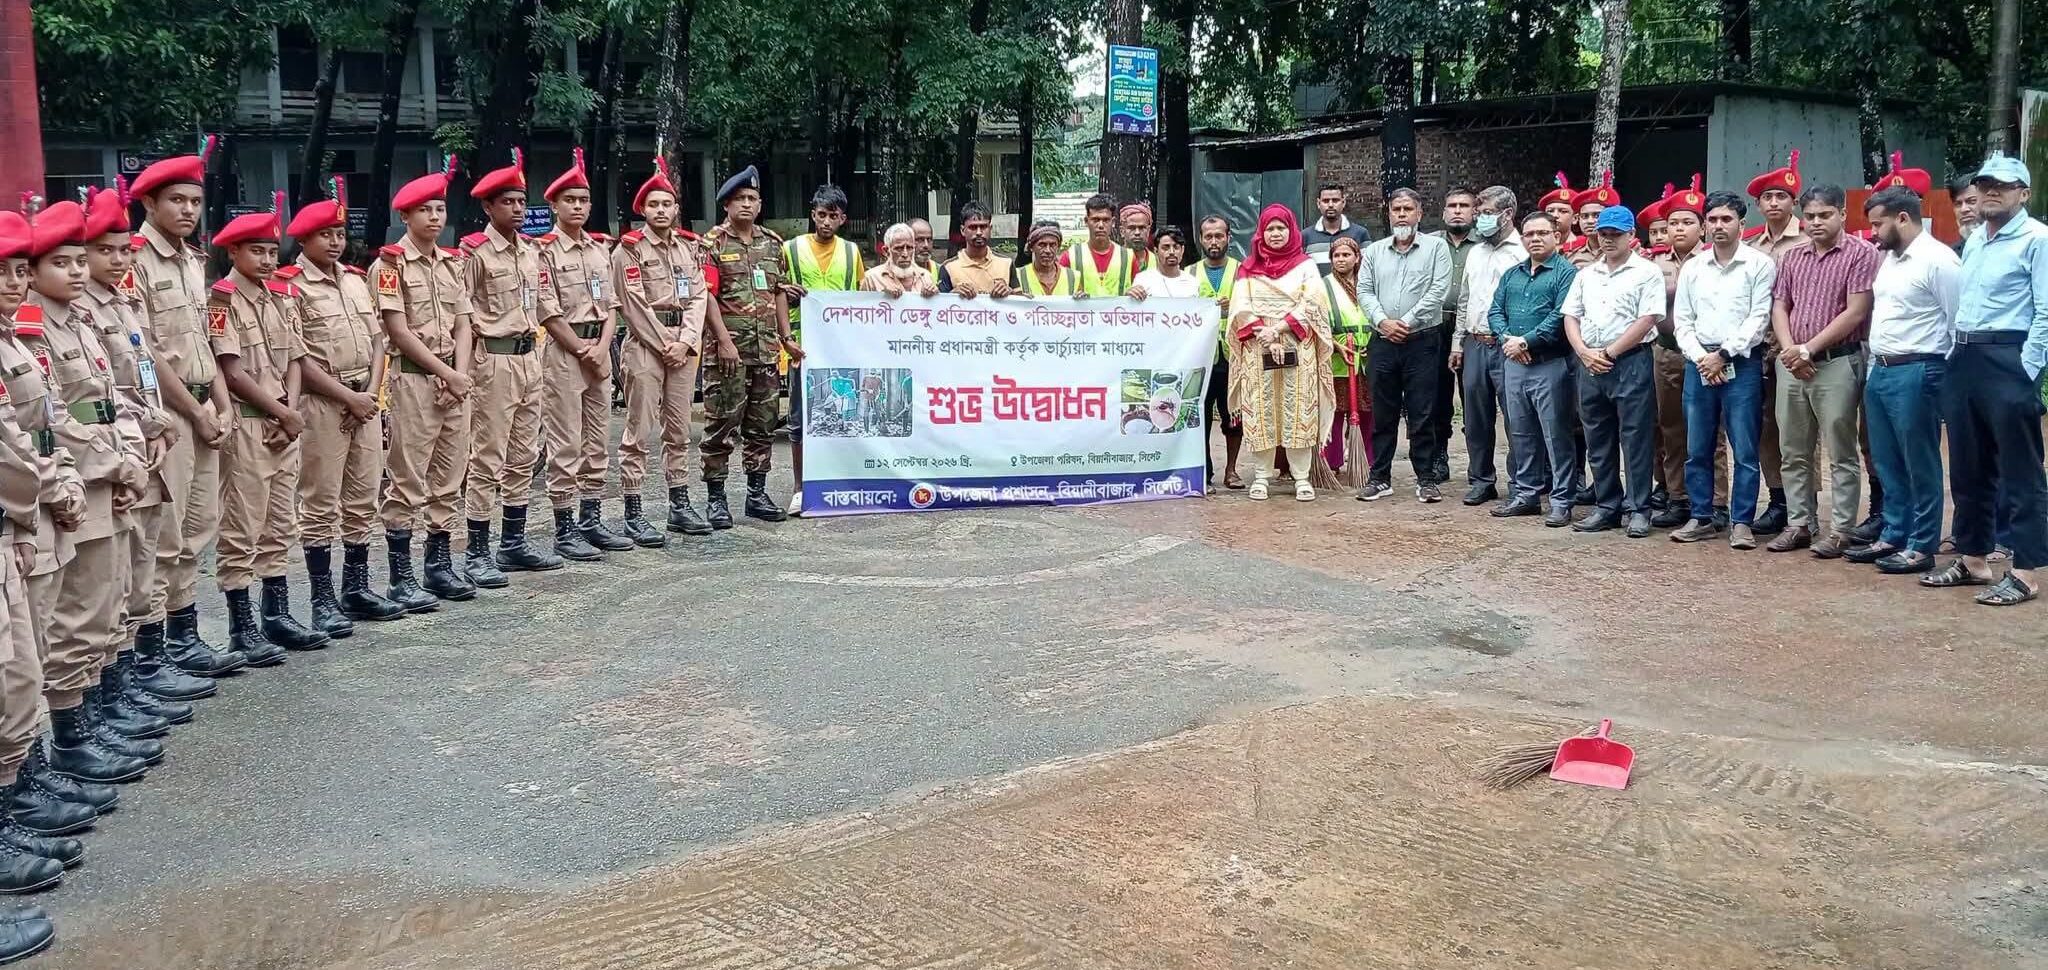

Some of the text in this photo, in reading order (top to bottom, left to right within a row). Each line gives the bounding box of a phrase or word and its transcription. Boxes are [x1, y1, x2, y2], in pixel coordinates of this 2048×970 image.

[822, 302, 1203, 331] দেশব্যাপী ডেঙ্গু প্রতিরোধ ও পরিচ্ছন্নতা অভিযান ২০২৬
[887, 335, 936, 354] মাননীয়
[939, 336, 1000, 357] প্রধানমন্ত্রী
[1003, 337, 1041, 361] কর্তৃক
[1101, 342, 1146, 357] মাধ্যমে
[927, 374, 1108, 425] শুভ উদ্বোধন
[877, 458, 890, 469] ১২
[932, 457, 957, 469] ২০২৬
[1020, 450, 1162, 466] উপজেলা পরিষদ, বিয়ানীবাজার, সিলেট
[822, 488, 898, 507] বাস্তবায়নে:
[936, 484, 998, 502] উপজেলা
[1001, 484, 1055, 502] প্রশাসন,
[1056, 479, 1138, 500] বিয়ানীবাজার,
[1142, 476, 1184, 496] সিলেট
